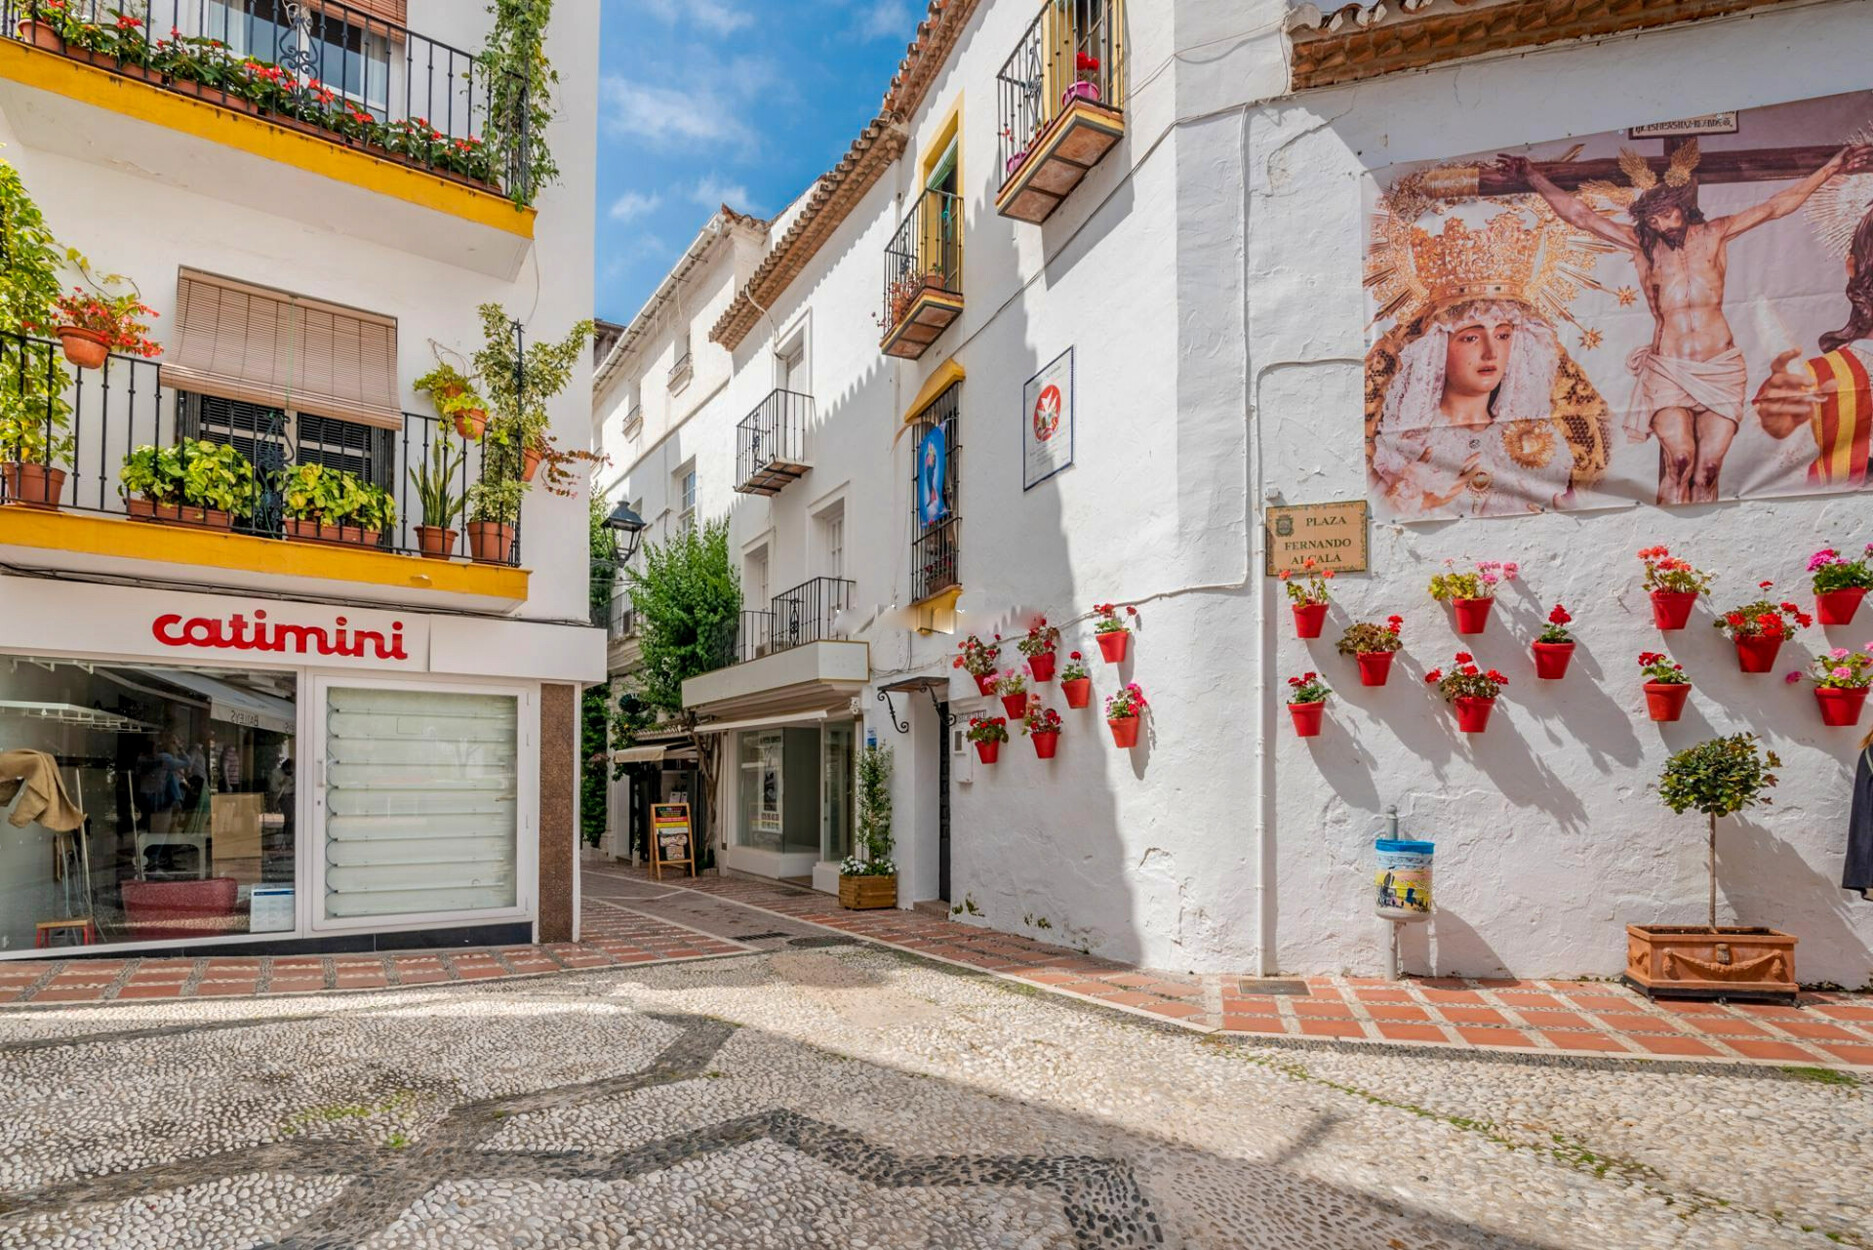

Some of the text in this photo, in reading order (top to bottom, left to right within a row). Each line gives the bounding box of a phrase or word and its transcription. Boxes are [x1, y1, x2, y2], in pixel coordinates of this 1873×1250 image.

[1306, 516, 1347, 527] PLAZA
[1285, 538, 1352, 551] FERNANDO
[152, 609, 408, 660] catimini
